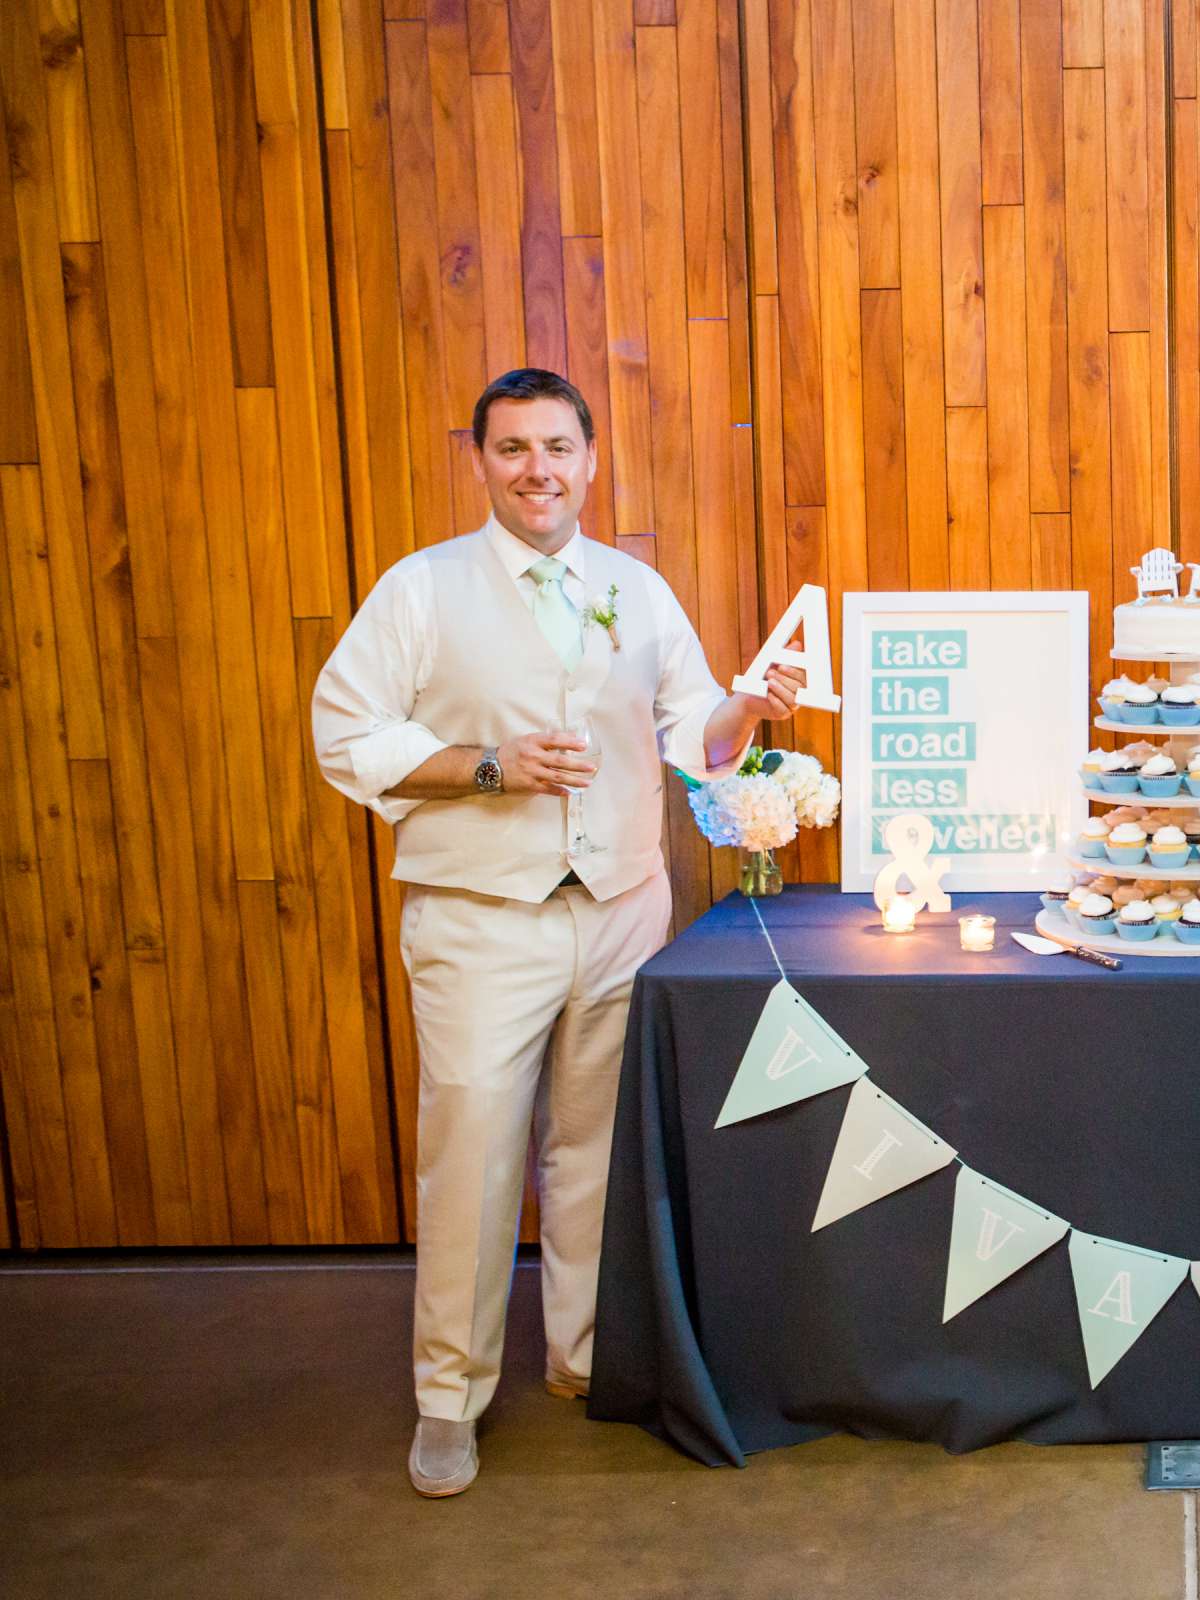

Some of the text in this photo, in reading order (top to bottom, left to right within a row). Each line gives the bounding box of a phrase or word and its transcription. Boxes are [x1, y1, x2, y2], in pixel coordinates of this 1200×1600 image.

[731, 583, 842, 713] A
[878, 633, 962, 666] take
[878, 680, 942, 712] the
[879, 726, 968, 758] road
[879, 772, 960, 805] less
